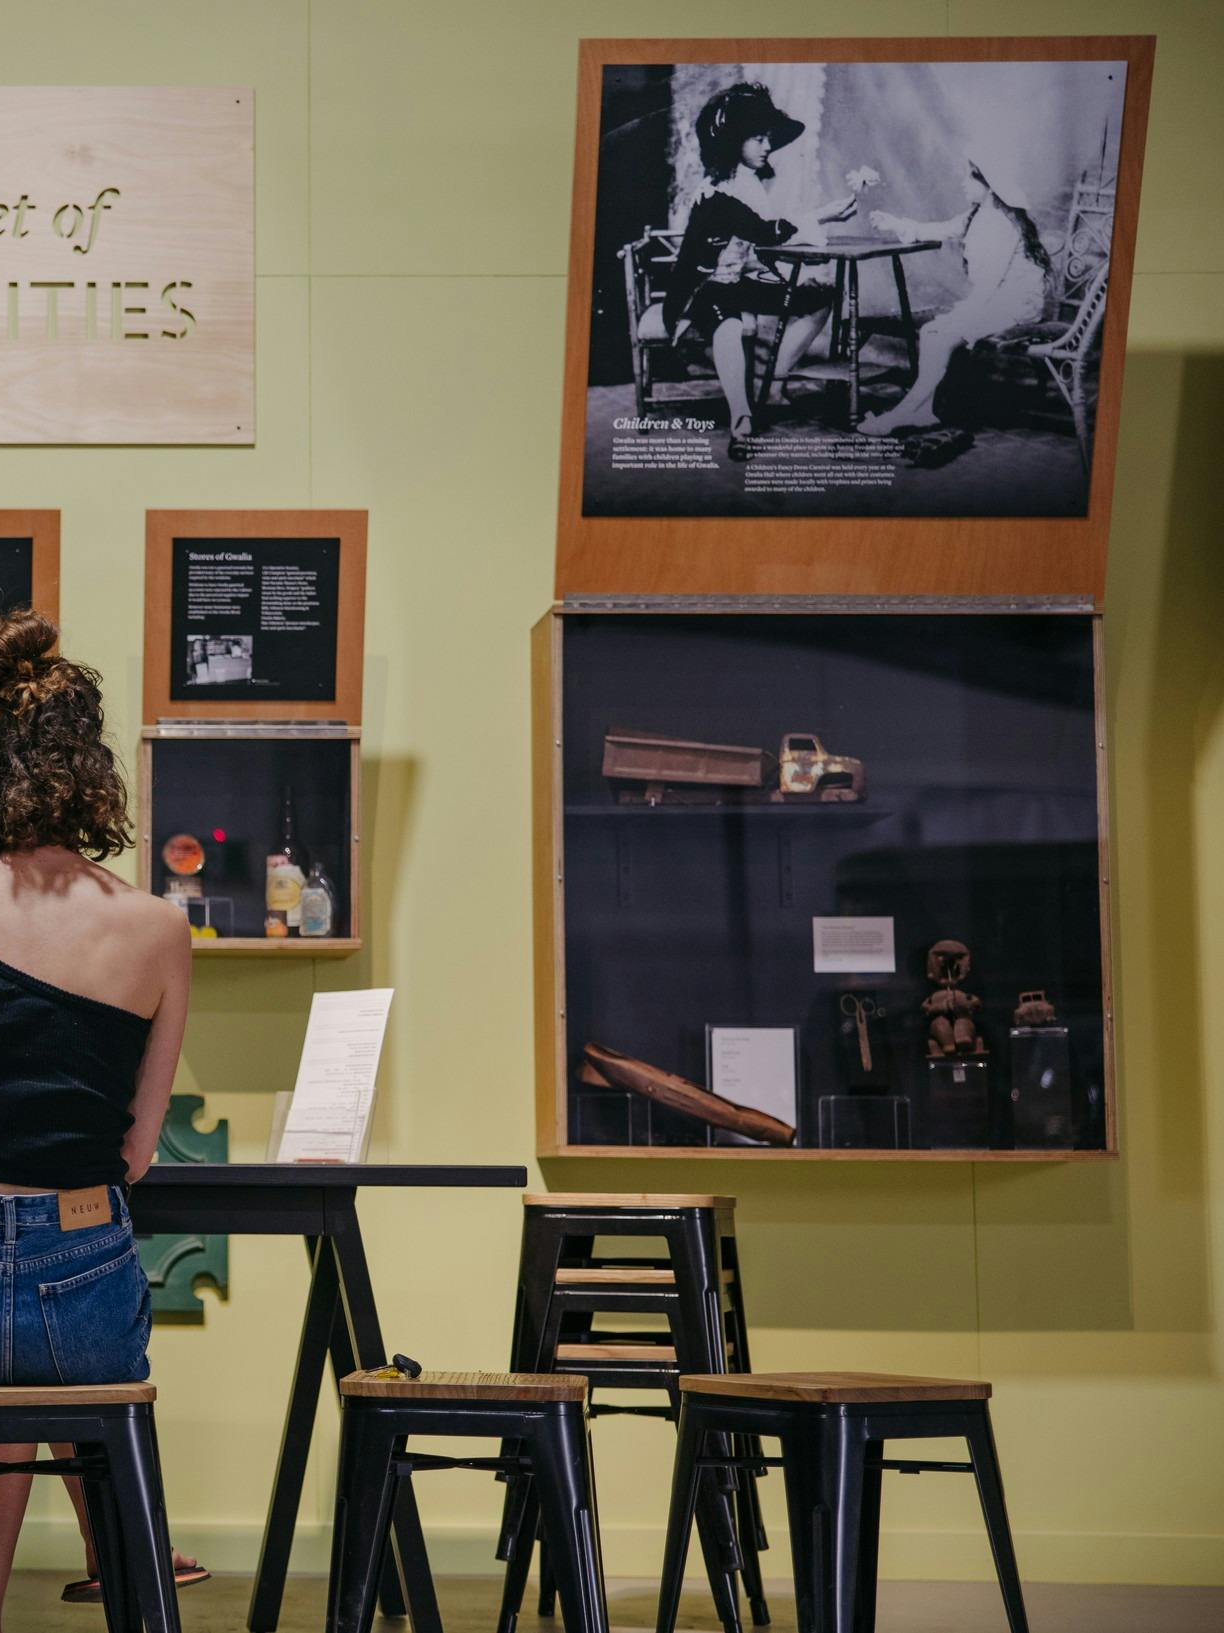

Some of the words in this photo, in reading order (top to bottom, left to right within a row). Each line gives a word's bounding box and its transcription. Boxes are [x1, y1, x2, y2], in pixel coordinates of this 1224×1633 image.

[52, 188, 120, 253] of
[613, 416, 668, 430] Children
[671, 418, 683, 430] &
[686, 418, 716, 432] Toys
[189, 552, 214, 561] Stores
[215, 552, 225, 561] of
[225, 552, 252, 561] Gwalia
